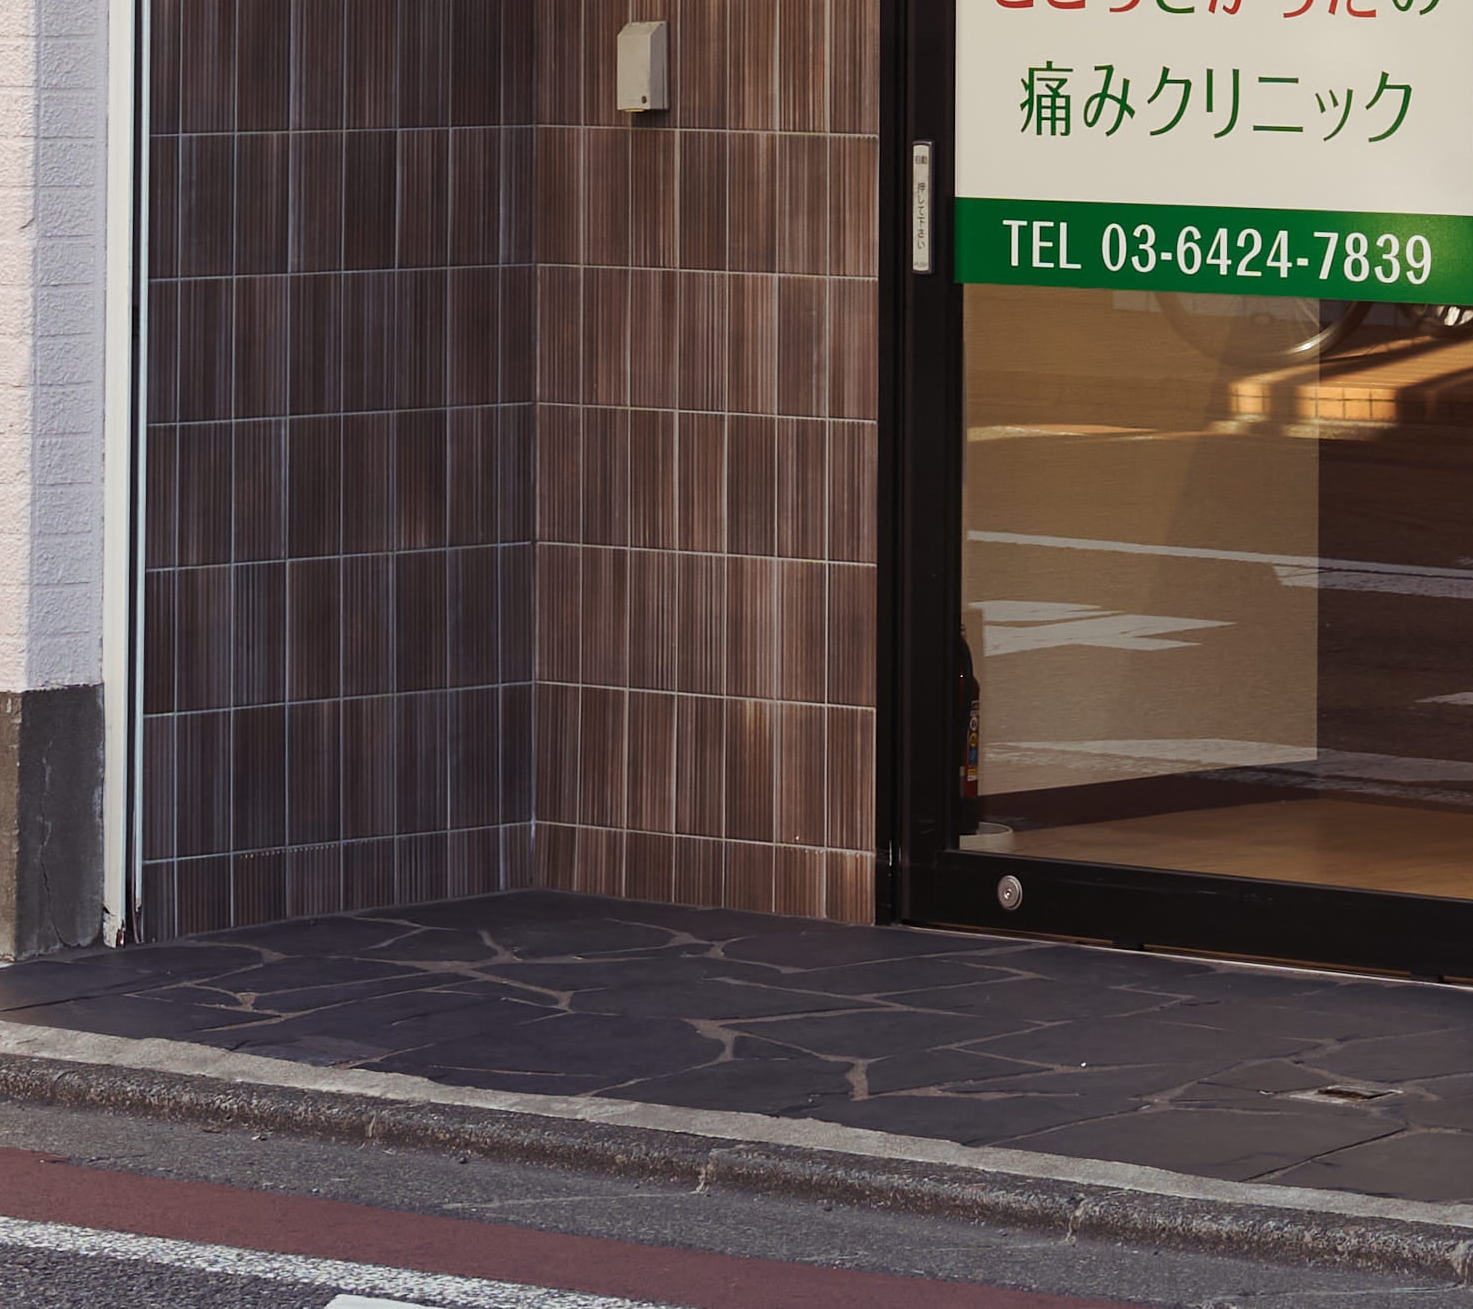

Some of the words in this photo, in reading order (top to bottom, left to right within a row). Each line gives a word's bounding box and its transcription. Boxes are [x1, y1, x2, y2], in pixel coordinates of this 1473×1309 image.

[1020, 60, 1413, 142] 痛みクリニック
[1003, 220, 1081, 270] TEL
[1101, 223, 1433, 285] 03-6424-7839
